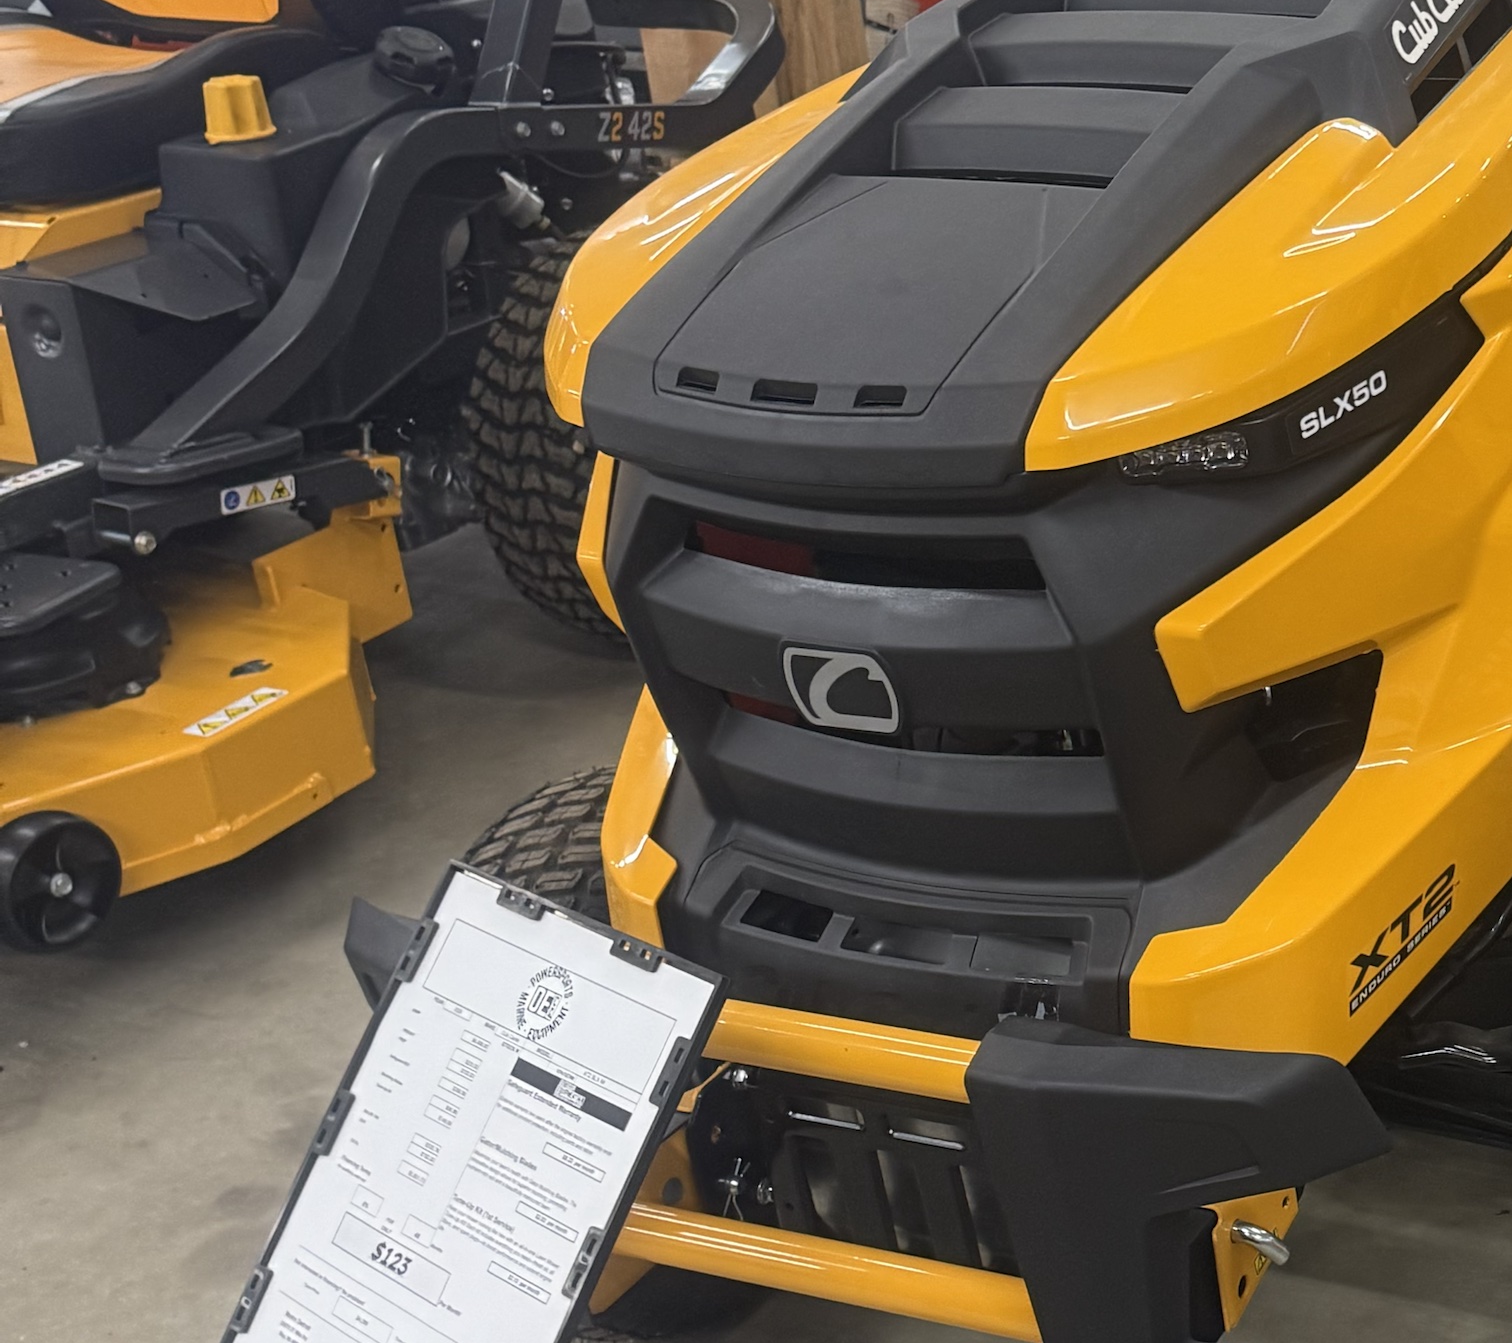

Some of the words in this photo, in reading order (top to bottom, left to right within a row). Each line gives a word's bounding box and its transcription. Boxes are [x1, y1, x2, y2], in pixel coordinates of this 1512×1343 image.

[1391, 1, 1439, 65] Cub
[598, 111, 623, 143] Z2
[628, 110, 666, 141] 42S
[1299, 369, 1388, 440] SLX50
[1349, 862, 1456, 998] XT2
[1350, 953, 1402, 1012] ENDURO
[1406, 906, 1447, 954] SERIES
[368, 1237, 414, 1278] $123
